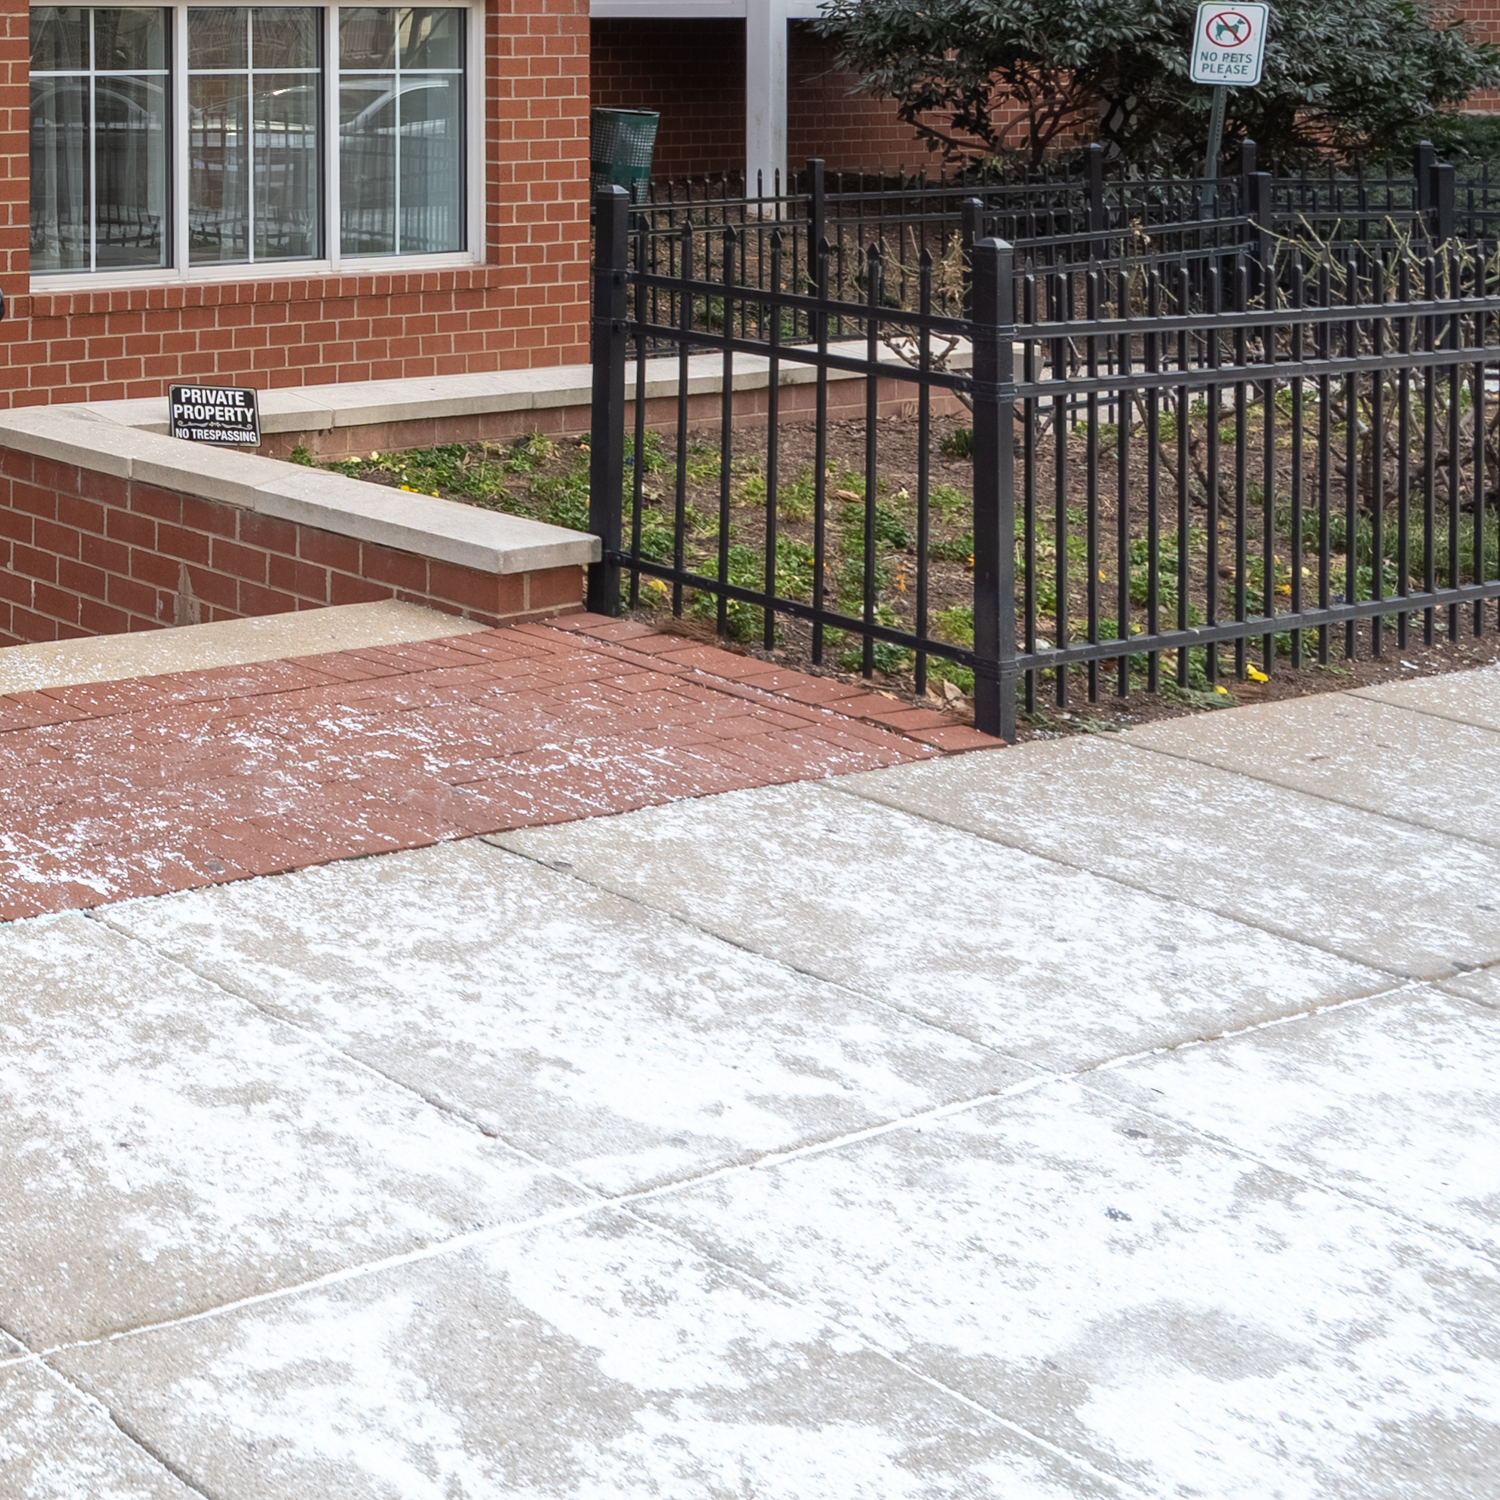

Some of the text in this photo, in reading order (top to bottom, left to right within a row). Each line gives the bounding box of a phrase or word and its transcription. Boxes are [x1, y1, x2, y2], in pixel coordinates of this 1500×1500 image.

[1200, 51, 1253, 64] NO PETS
[1201, 63, 1249, 75] PLEASE
[180, 388, 245, 406] PRIVATE
[173, 403, 254, 423] PROPERTY
[175, 428, 257, 443] NO TRESPASSING
